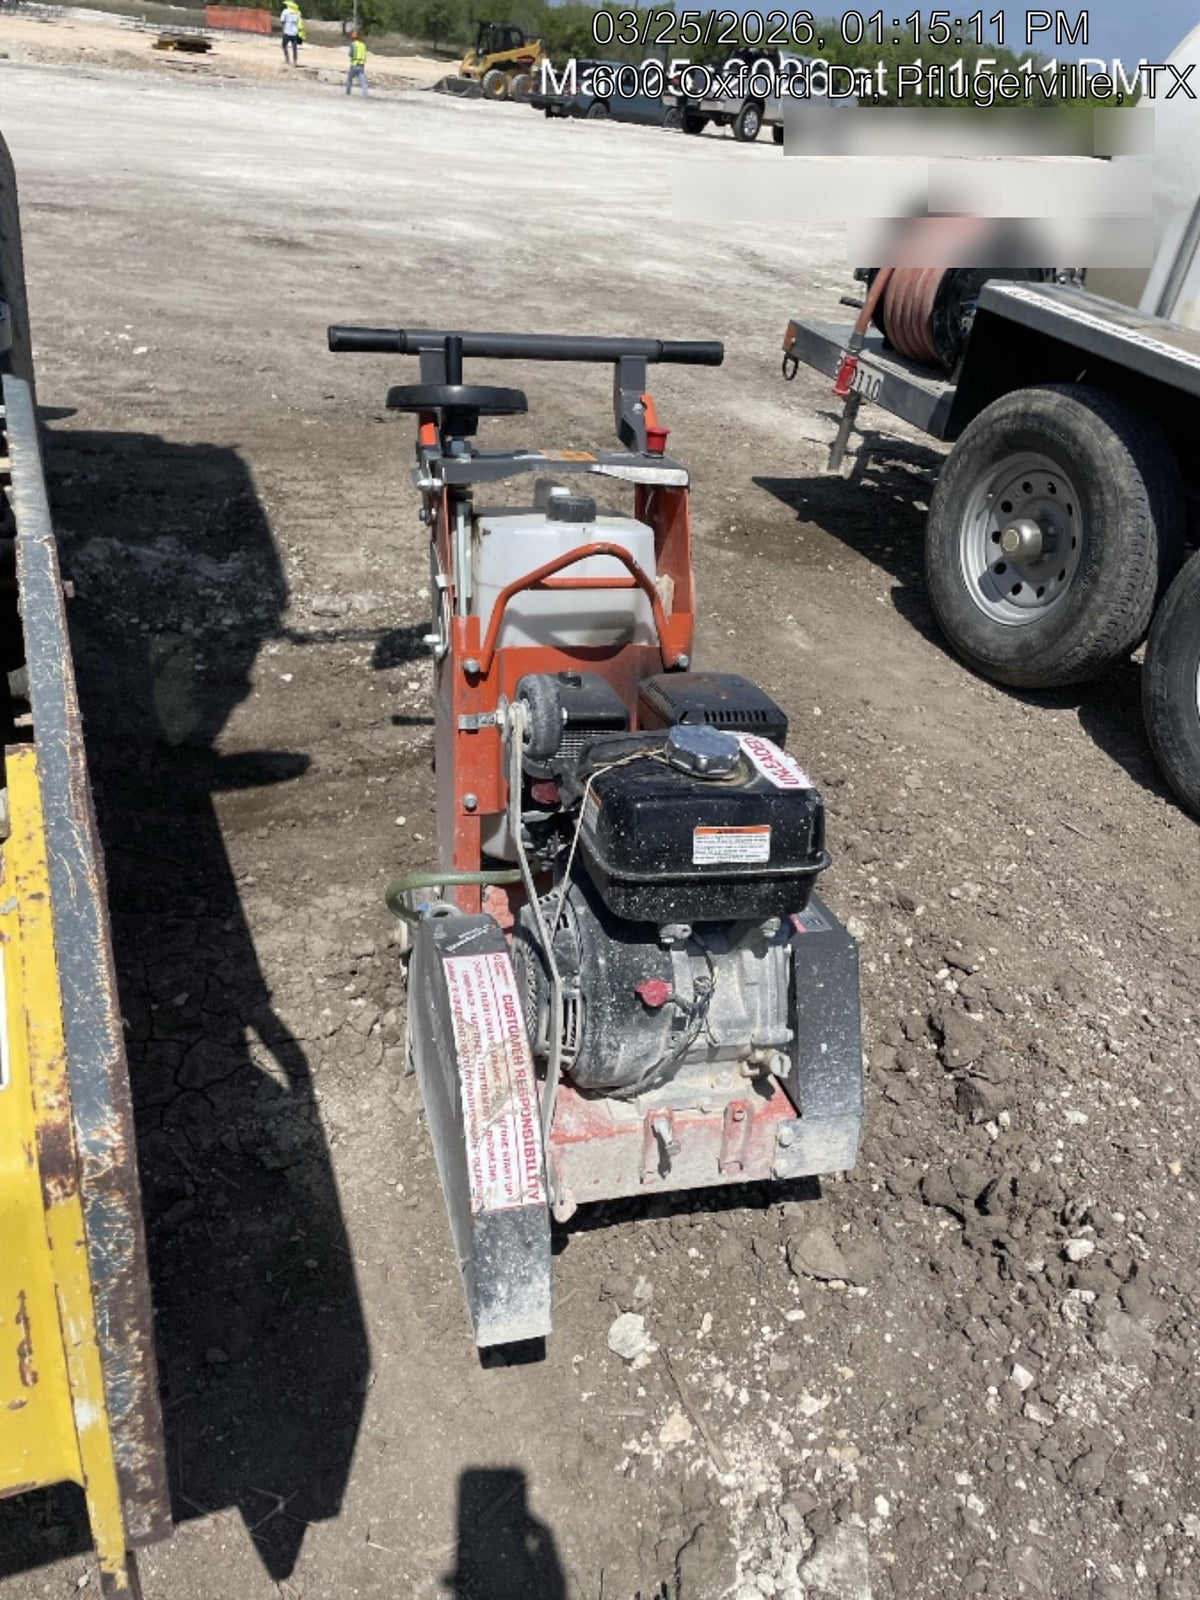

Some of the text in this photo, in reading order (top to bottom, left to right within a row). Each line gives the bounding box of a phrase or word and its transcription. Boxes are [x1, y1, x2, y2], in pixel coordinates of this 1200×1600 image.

[743, 737, 800, 785] UNLEADED
[502, 993, 541, 1201] CUSTOMER RESPONSIBILITY
